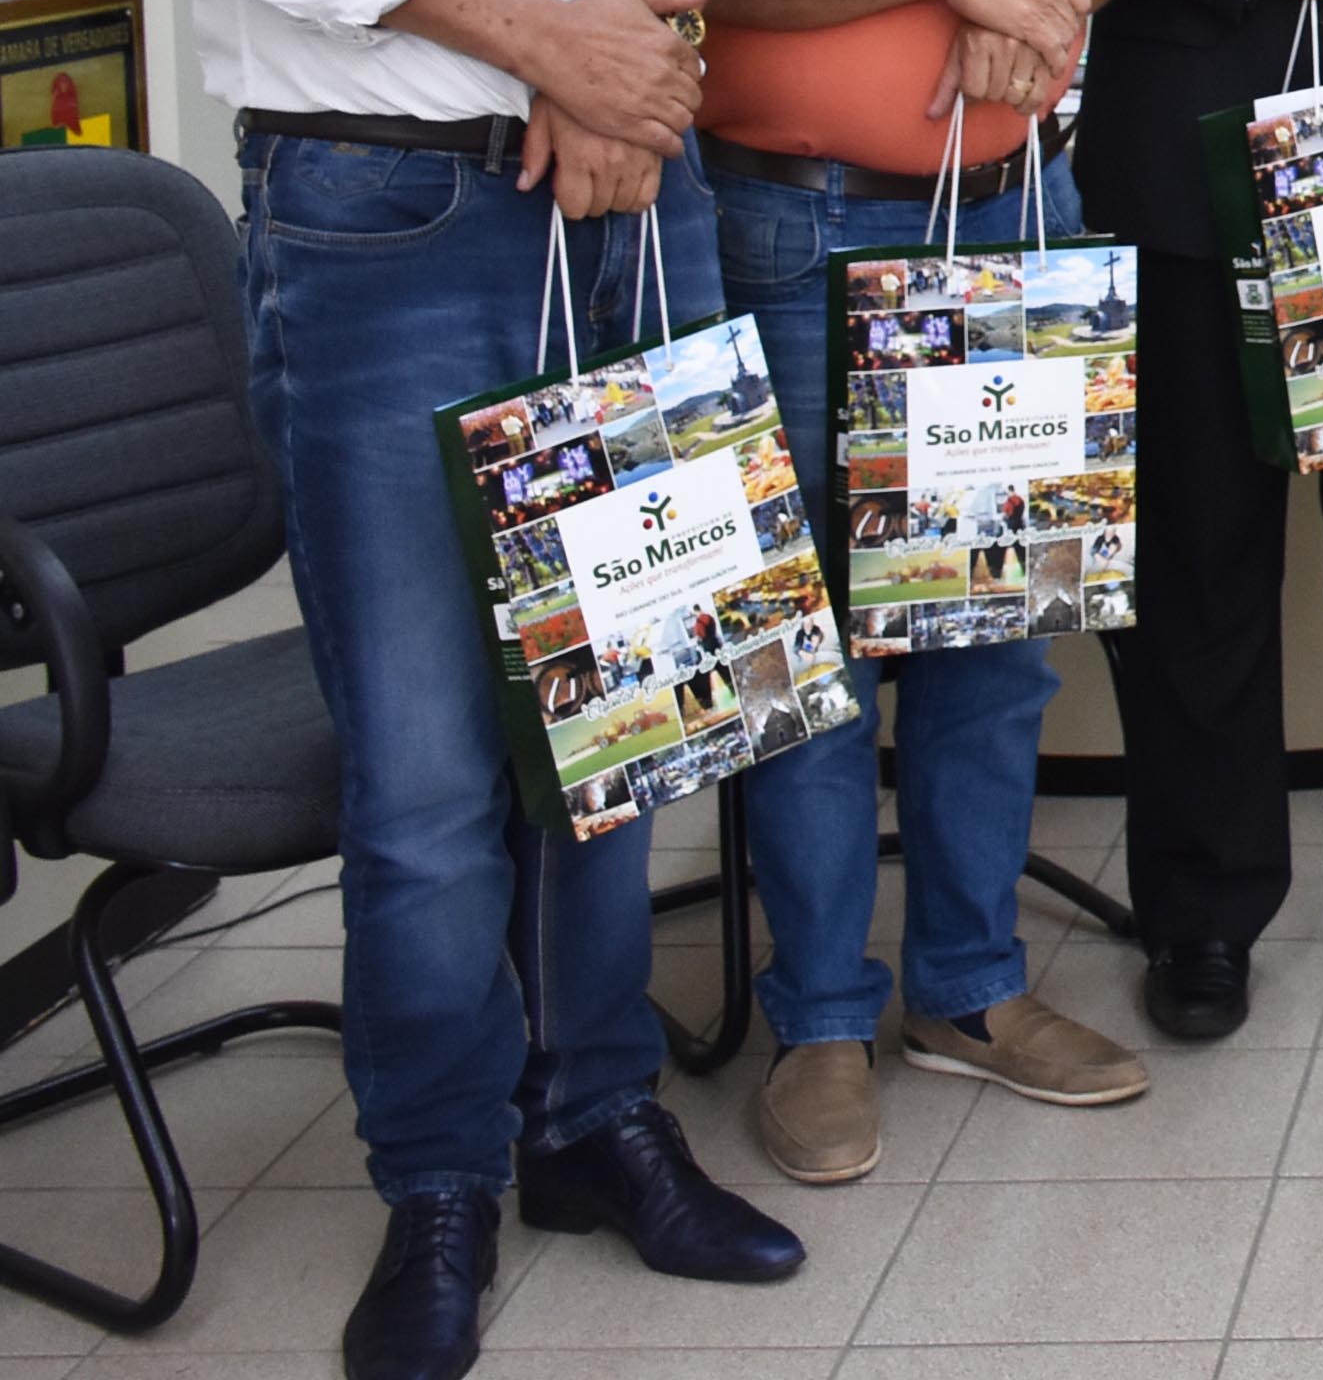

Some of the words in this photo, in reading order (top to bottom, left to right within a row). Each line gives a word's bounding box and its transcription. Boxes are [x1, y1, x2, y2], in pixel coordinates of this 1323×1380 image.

[926, 424, 972, 446] São
[978, 420, 1068, 441] Marcos
[593, 557, 643, 589] São
[645, 519, 737, 568] Marcos
